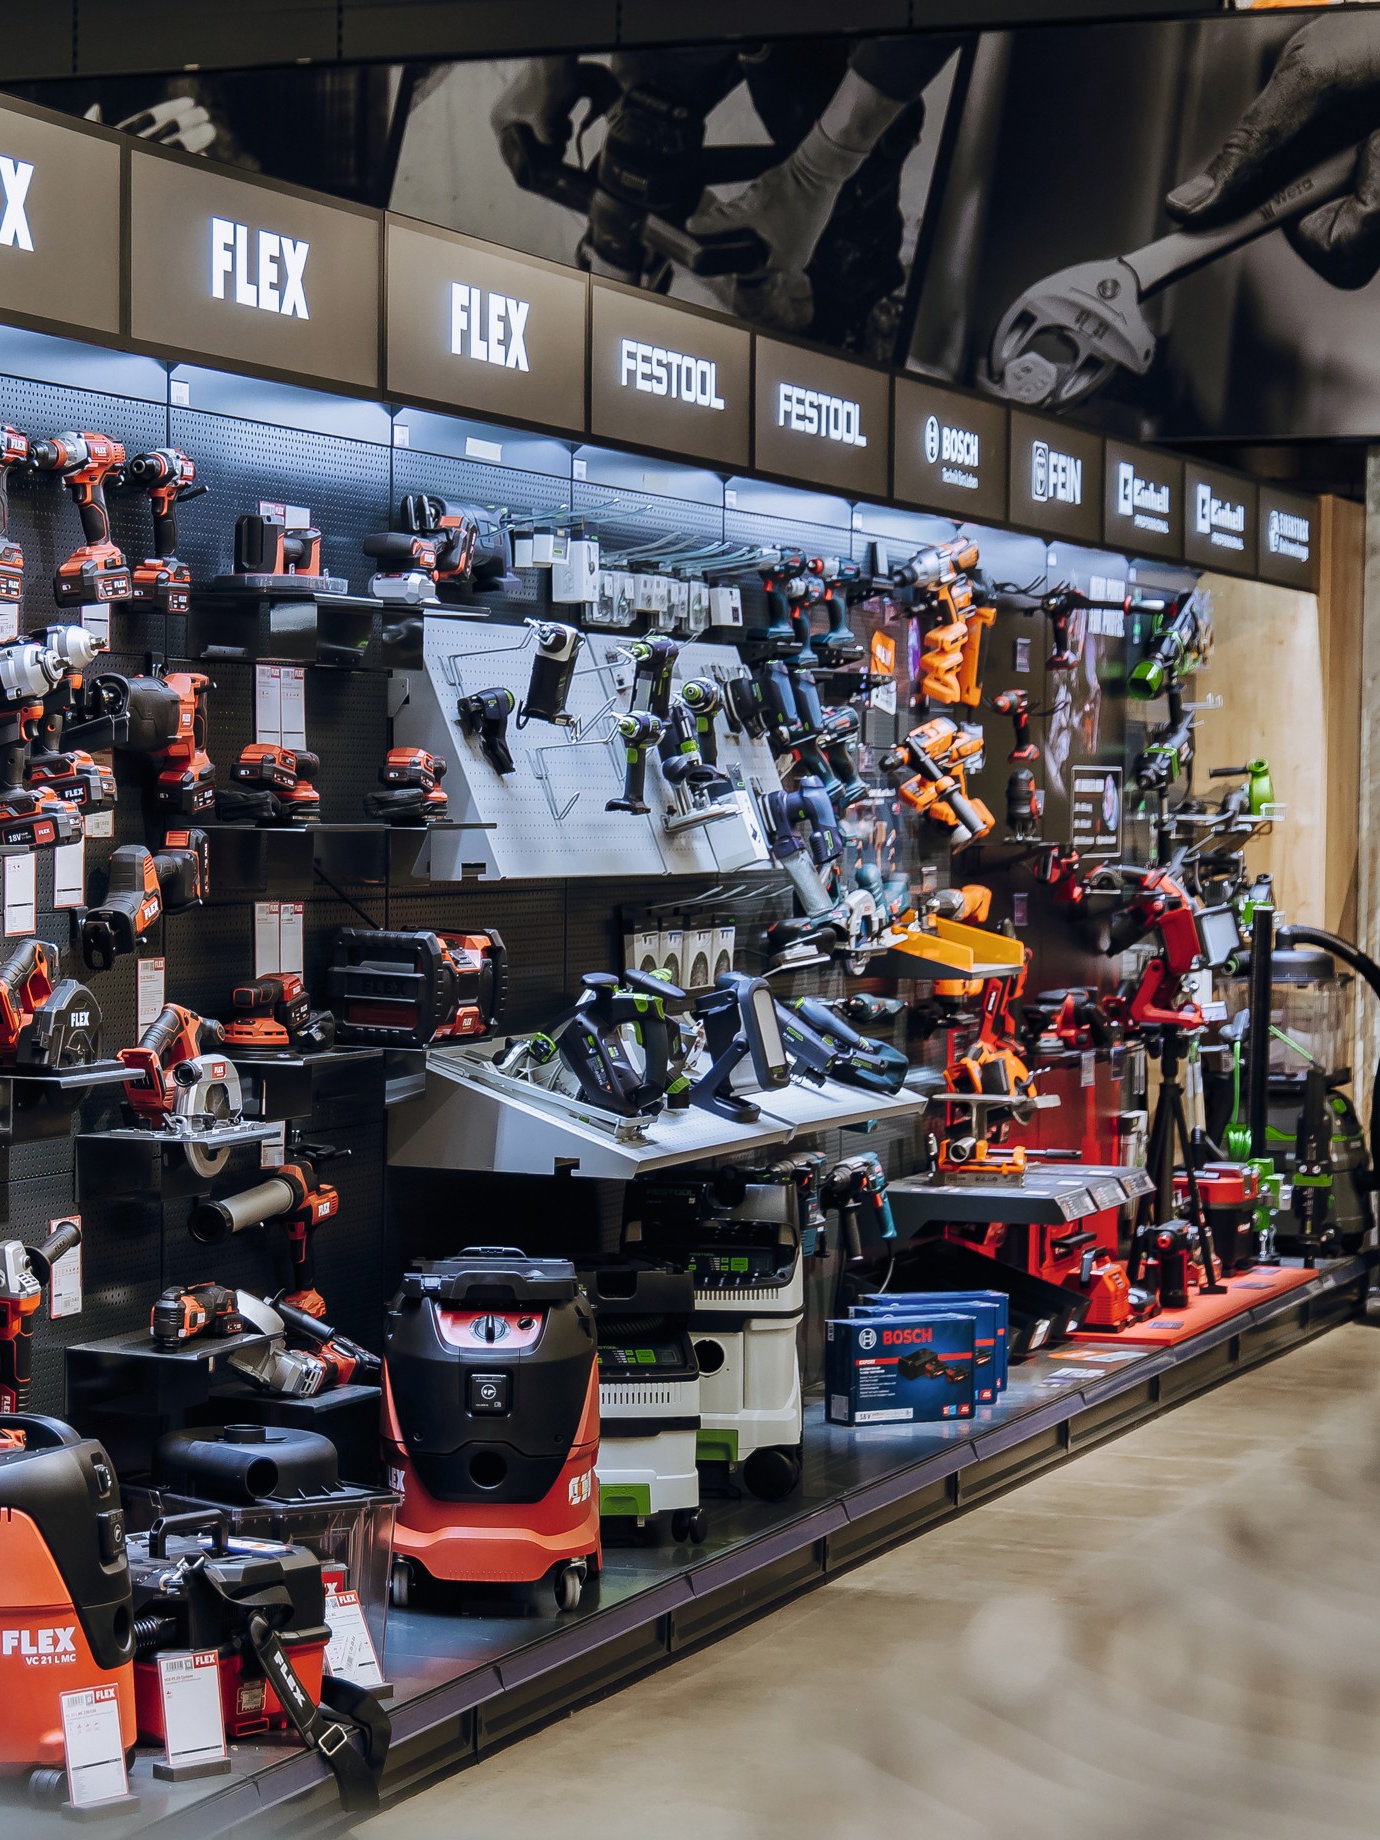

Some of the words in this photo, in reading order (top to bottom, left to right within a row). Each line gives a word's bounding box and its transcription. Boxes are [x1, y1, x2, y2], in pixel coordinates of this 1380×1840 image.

[211, 216, 310, 320] FLEX
[451, 282, 530, 372] FLEX
[621, 338, 725, 410] FESTOOL
[778, 382, 867, 448] FESTOOL
[11, 439, 26, 451] FLEX
[95, 446, 106, 454] FLEX
[942, 427, 979, 467] BOSCH
[1048, 450, 1082, 505] FEIN
[8, 580, 19, 589] FLEX
[114, 580, 126, 588] FLEX
[65, 787, 84, 798] FLEX
[8, 833, 21, 843] 18V
[143, 900, 159, 920] FLEX
[71, 1012, 90, 1027] FLEX
[882, 1328, 933, 1345] BOSCH
[389, 1467, 406, 1492] LEX
[339, 1594, 357, 1604] FLEX
[2, 1626, 76, 1655] FLEX
[25, 1656, 40, 1666] VC
[40, 1655, 52, 1665] 21
[54, 1655, 60, 1664] L
[61, 1653, 76, 1663] MC
[195, 1653, 215, 1666] FLEX
[273, 1650, 306, 1708] FLEX
[95, 1688, 115, 1700] FLEX
